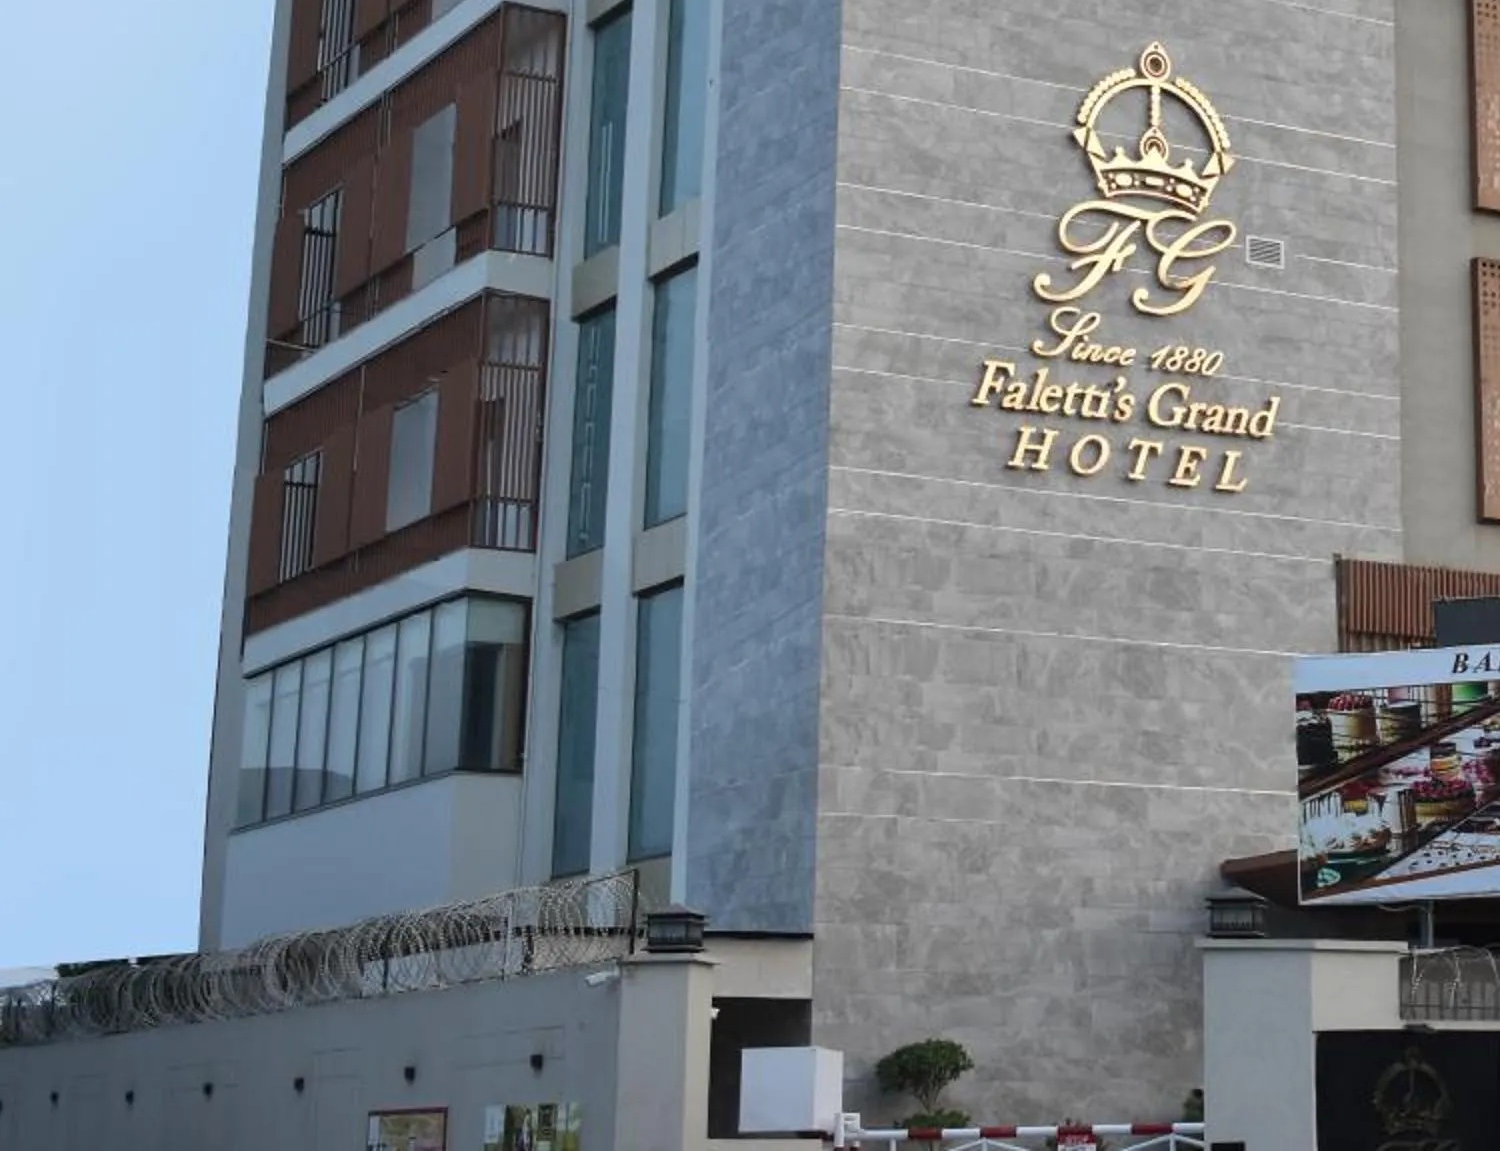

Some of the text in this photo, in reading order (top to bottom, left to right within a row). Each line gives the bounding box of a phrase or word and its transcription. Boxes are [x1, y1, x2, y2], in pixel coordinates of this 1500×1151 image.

[1032, 306, 1224, 376] Since 1880
[971, 360, 1281, 439] Faletti's Grand
[1007, 426, 1249, 492] HOTEL
